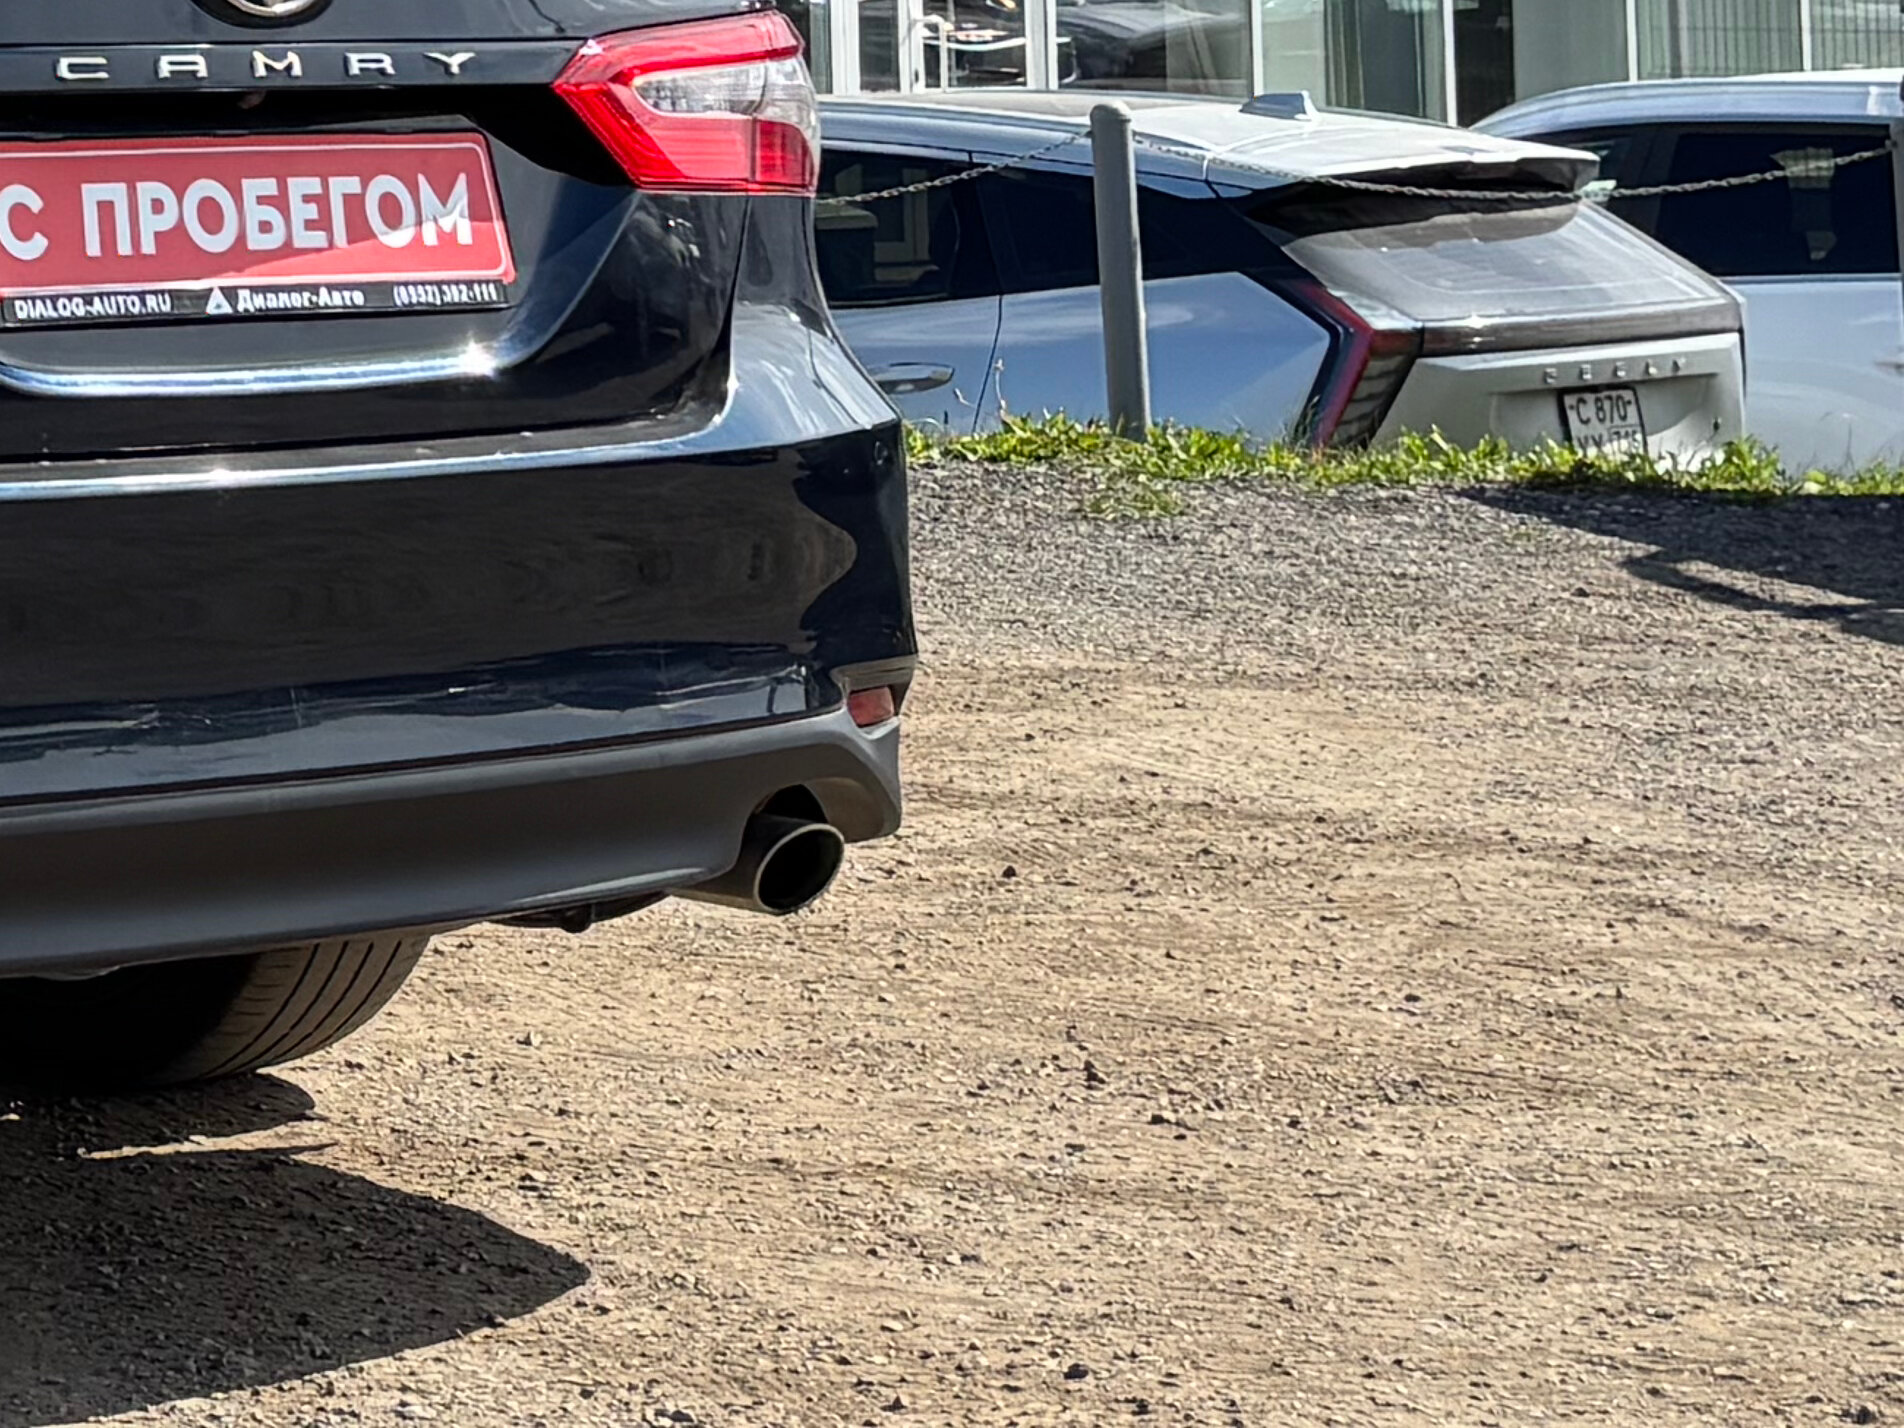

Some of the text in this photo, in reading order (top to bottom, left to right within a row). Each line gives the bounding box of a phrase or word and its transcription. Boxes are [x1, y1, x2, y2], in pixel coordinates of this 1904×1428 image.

[56, 49, 477, 80] CAMRY
[80, 172, 474, 257] ПРОБЕГОМ
[13, 292, 174, 321] DIALOG-AUTO.RU
[236, 285, 366, 313] Диалог-Авто
